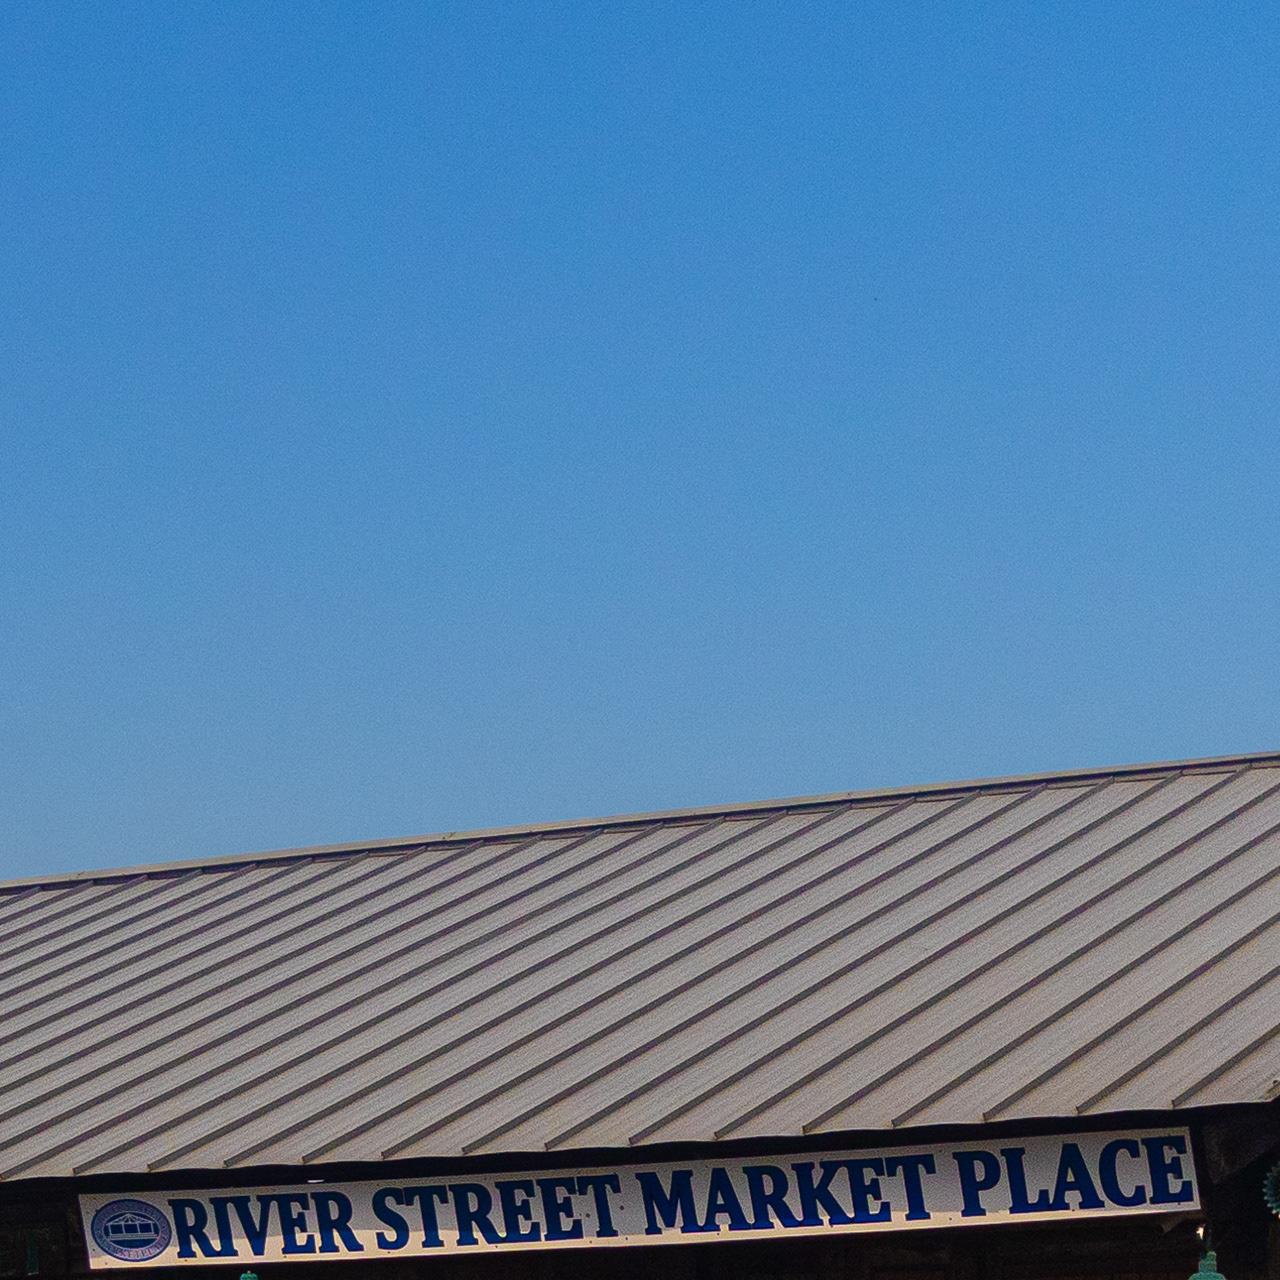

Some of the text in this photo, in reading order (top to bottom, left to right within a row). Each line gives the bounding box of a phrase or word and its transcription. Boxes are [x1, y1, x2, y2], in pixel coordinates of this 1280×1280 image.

[168, 1135, 1194, 1258] RIVER STREET MARKET PLACE
